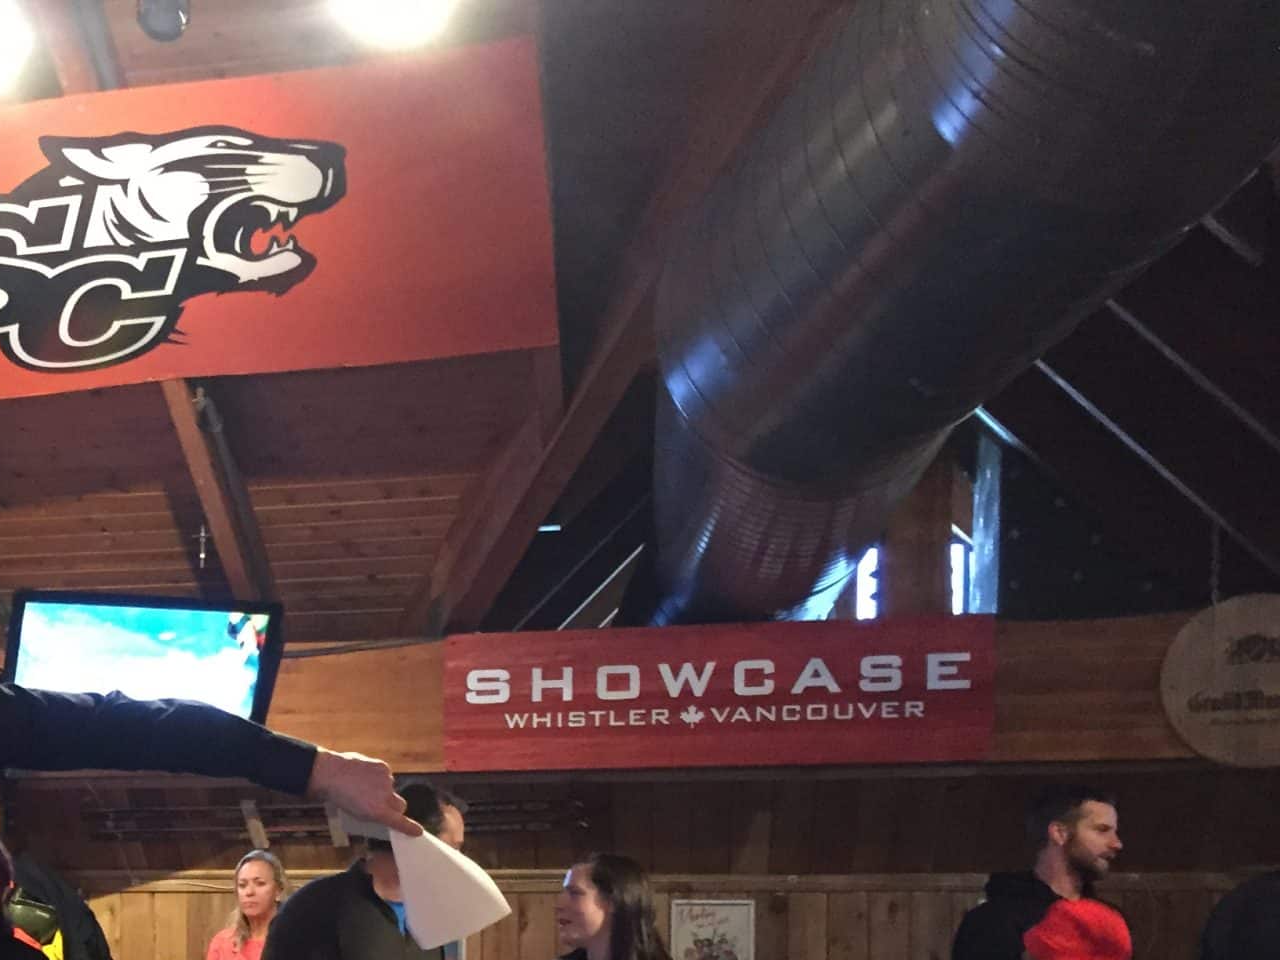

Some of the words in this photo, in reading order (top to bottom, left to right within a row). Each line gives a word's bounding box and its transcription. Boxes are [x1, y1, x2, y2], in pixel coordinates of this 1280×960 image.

[465, 652, 971, 704] SHOWCASE
[504, 709, 669, 729] WHISTLER
[710, 701, 925, 725] VANCOUVER
